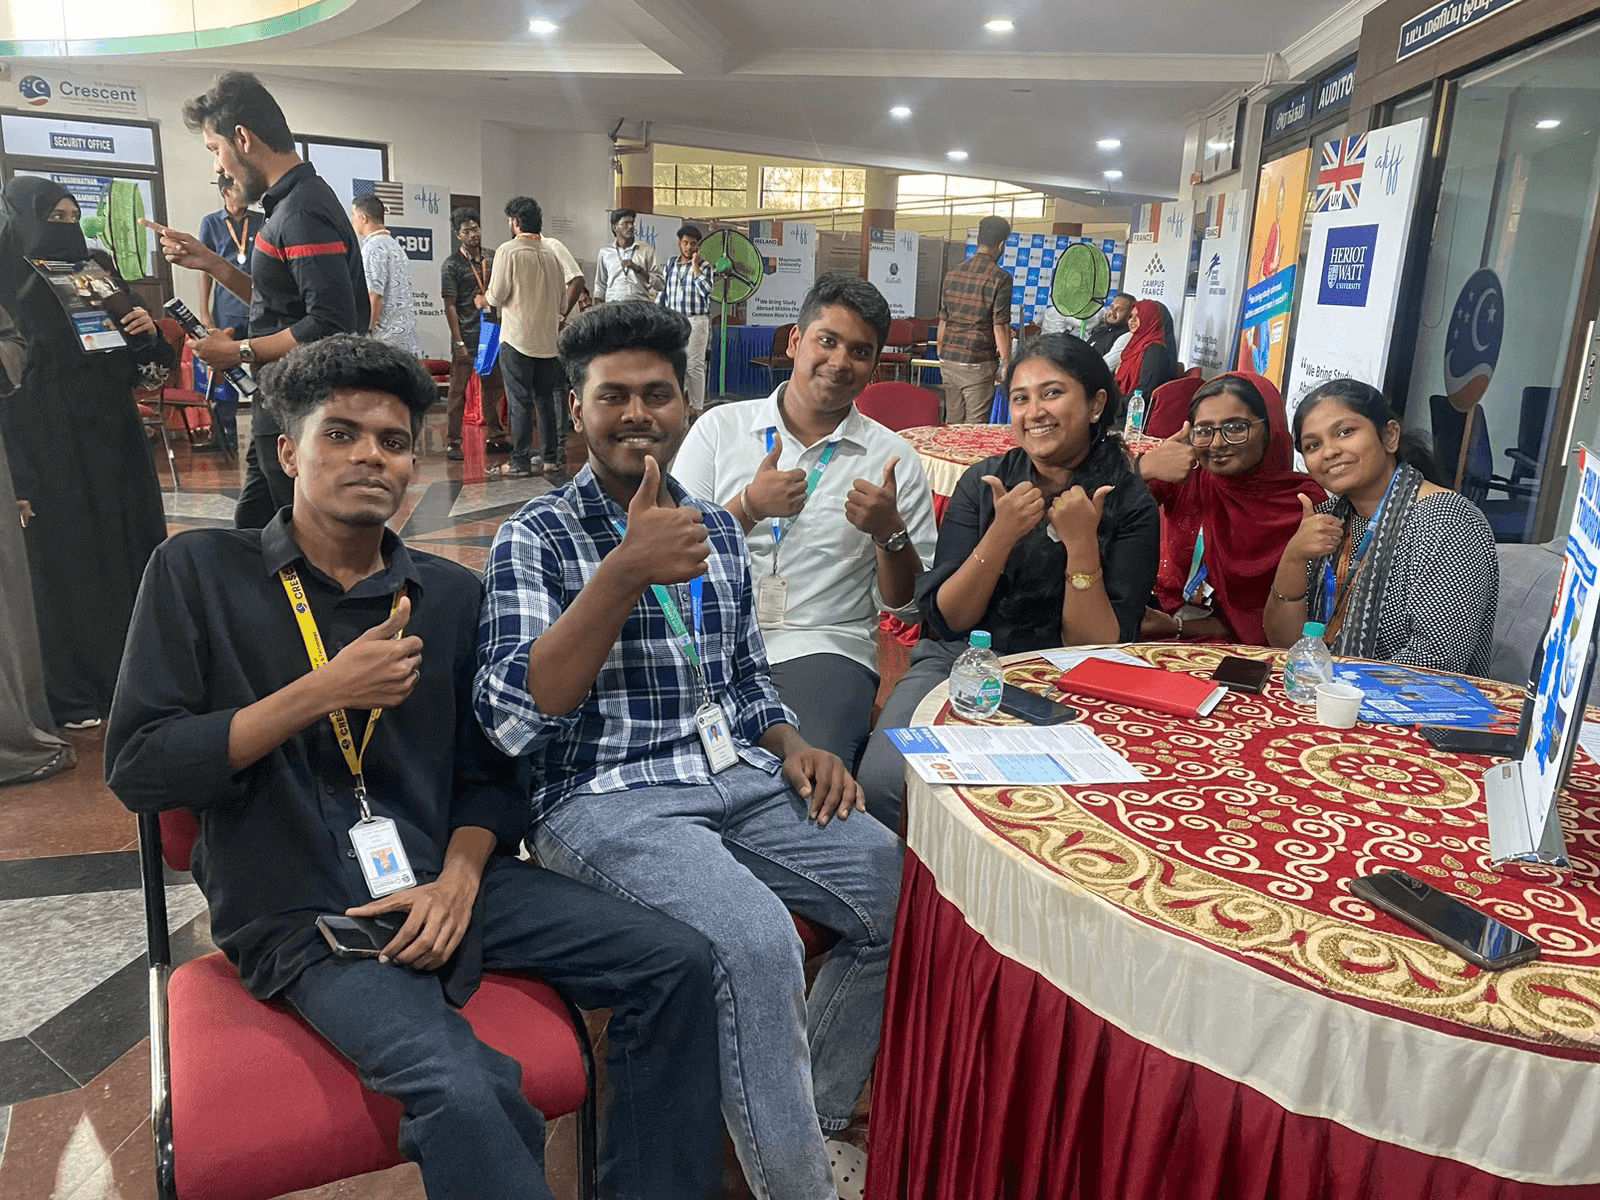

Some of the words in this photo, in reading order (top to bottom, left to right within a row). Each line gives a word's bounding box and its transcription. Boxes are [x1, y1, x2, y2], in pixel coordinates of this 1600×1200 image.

[59, 81, 137, 102] Crescent
[1318, 72, 1356, 110] AUDITO
[53, 136, 87, 148] SECURITY
[88, 138, 111, 150] OFFICE
[1330, 193, 1340, 207] UK
[395, 236, 431, 252] CBU
[1133, 234, 1153, 242] FRANCE
[1330, 246, 1368, 264] HERIOT
[1337, 264, 1364, 281] WATT
[1142, 280, 1165, 288] CAMPUS
[412, 291, 428, 299] tudy
[1141, 288, 1164, 296] FRANCE
[1315, 365, 1333, 380] Bring
[285, 567, 304, 600] CRESC
[334, 710, 348, 736] CRES
